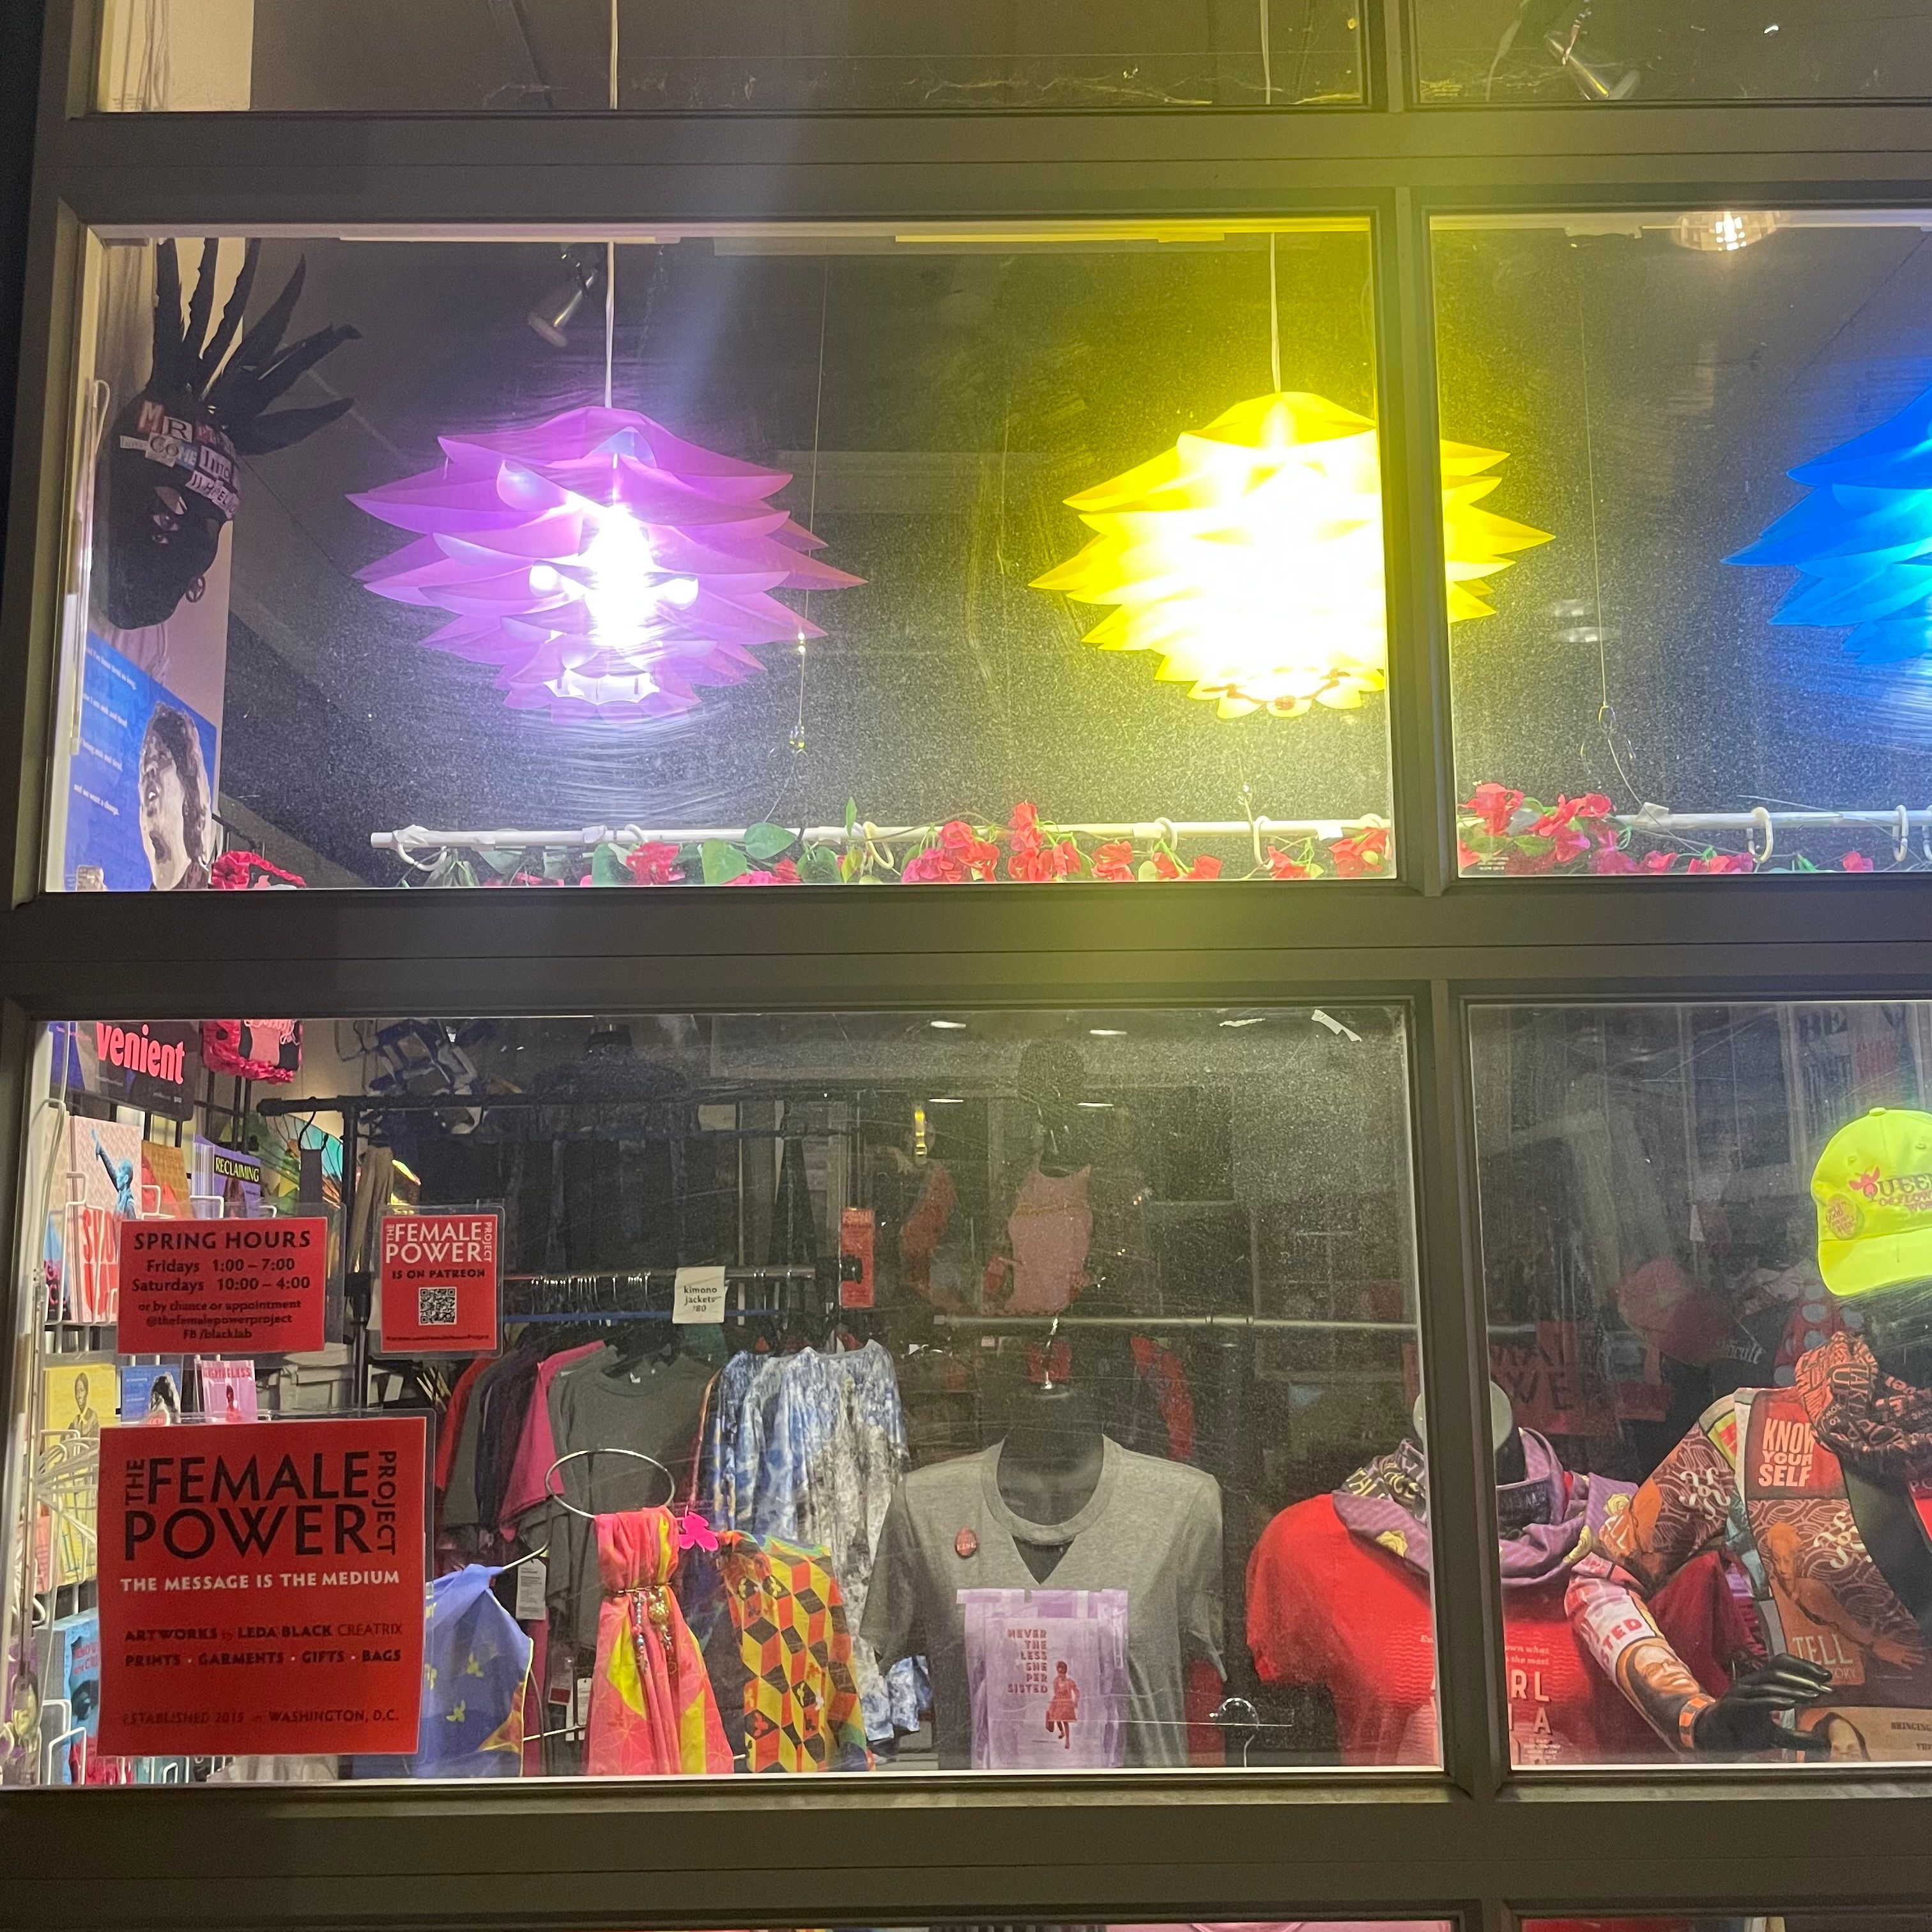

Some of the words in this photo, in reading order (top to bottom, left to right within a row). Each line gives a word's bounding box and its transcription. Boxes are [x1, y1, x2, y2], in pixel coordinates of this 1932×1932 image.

[96, 1022, 183, 1084] venient
[215, 1156, 259, 1183] RECLAIMING
[134, 1232, 217, 1250] SPRING
[226, 1230, 311, 1249] HOURS
[386, 1223, 395, 1243] THE
[395, 1222, 482, 1243] FEMALE
[482, 1222, 493, 1263] PROJECT
[385, 1242, 483, 1264] POWER
[146, 1259, 200, 1276] Fridays
[212, 1259, 244, 1272] 1:00
[261, 1258, 295, 1271] 7:00
[392, 1271, 402, 1280] IS
[406, 1270, 425, 1279] ON
[429, 1269, 486, 1278] PATREON
[132, 1278, 204, 1294] Saturdays
[217, 1278, 259, 1291] 10:00
[276, 1276, 310, 1289] 4:00
[684, 1285, 717, 1294] kimono
[153, 1301, 166, 1314] by
[226, 1300, 302, 1313] appointment
[684, 1295, 716, 1306] jackets
[1762, 1450, 1813, 1466] YOUR
[1758, 1464, 1812, 1487] SELF
[125, 1459, 145, 1506] THE
[148, 1451, 369, 1505] FEMALE
[372, 1451, 397, 1555] PROJECT
[125, 1504, 372, 1561] POWER
[120, 1577, 157, 1591] THE
[164, 1575, 249, 1591] MESSAGE
[257, 1574, 272, 1588] IS
[280, 1572, 316, 1587] THE
[322, 1570, 399, 1586] MEDIUM
[125, 1627, 218, 1641] ARTWORKS
[238, 1626, 278, 1639] LEDA
[282, 1625, 332, 1637] BLACK
[337, 1623, 402, 1636] CREATRIX
[1008, 1629, 1046, 1638] NEVER
[1024, 1640, 1047, 1650] THE
[1792, 1633, 1853, 1665] TELL
[125, 1654, 181, 1667] PRINTS
[198, 1651, 284, 1665] GARMENTS
[302, 1650, 344, 1664] GIFTS
[362, 1648, 401, 1662] BAGS
[1020, 1651, 1048, 1660] LESS
[1025, 1662, 1048, 1671] SHE
[1025, 1673, 1048, 1682] PER
[1008, 1683, 1048, 1694] SISTED
[372, 1708, 399, 1722] D.C.
